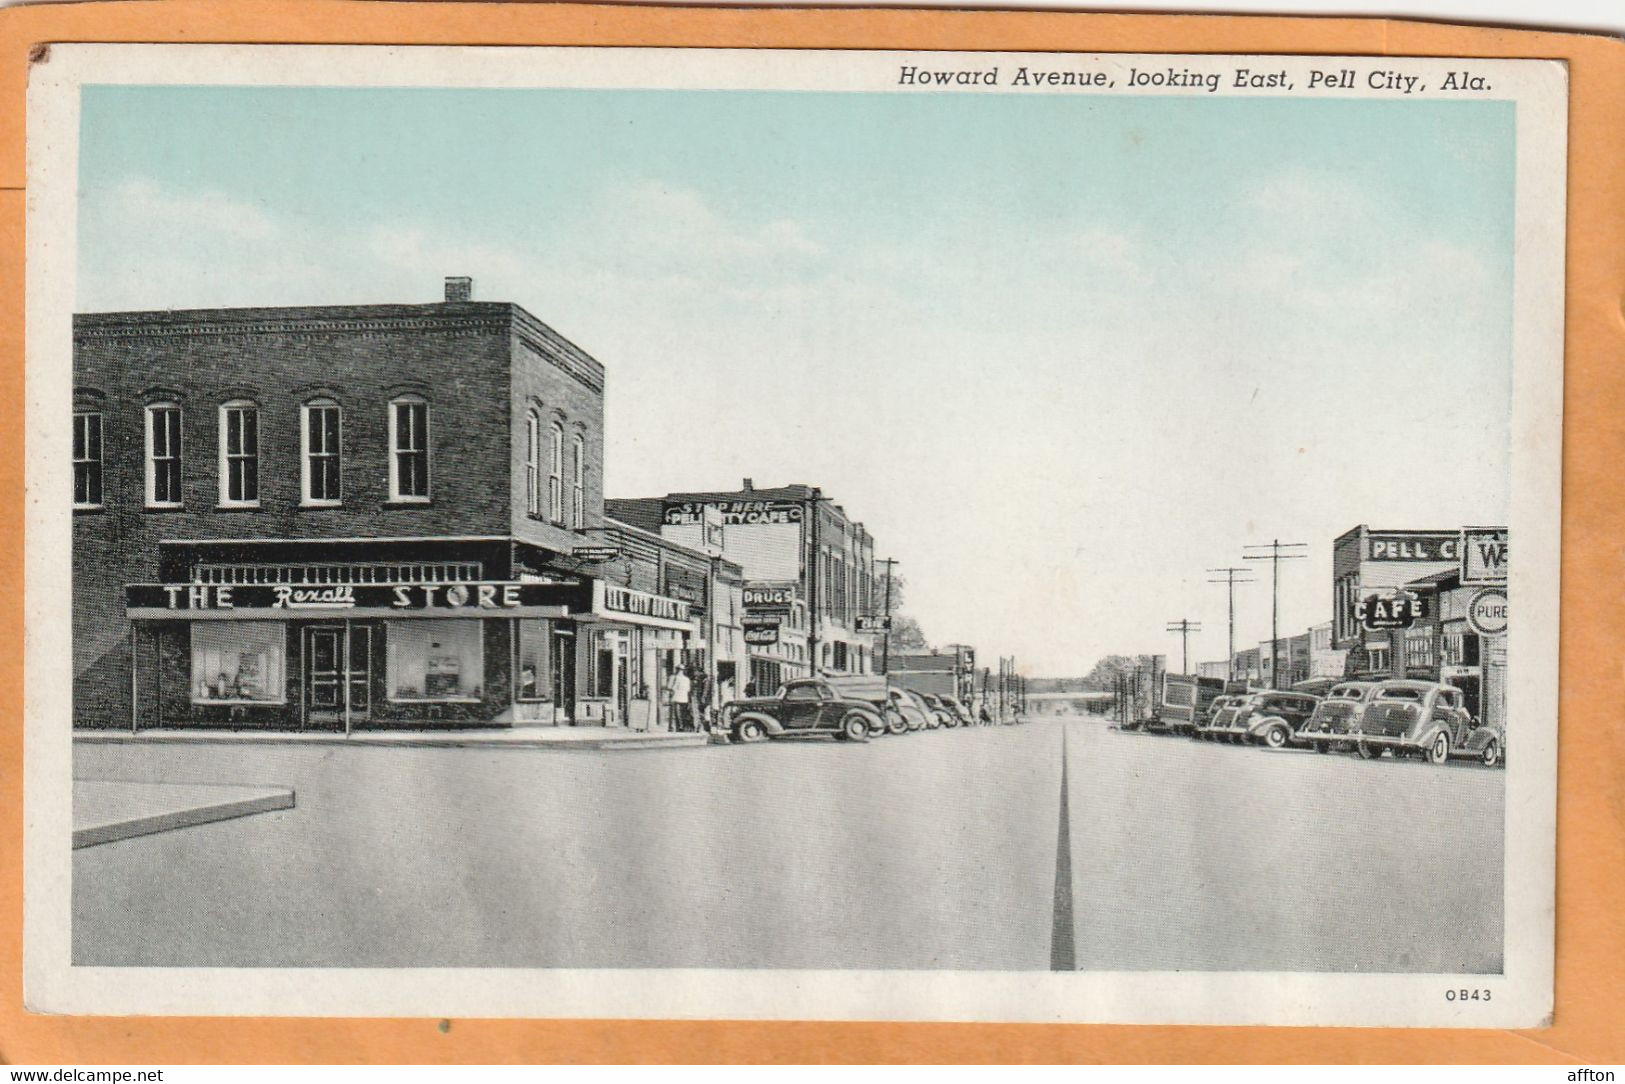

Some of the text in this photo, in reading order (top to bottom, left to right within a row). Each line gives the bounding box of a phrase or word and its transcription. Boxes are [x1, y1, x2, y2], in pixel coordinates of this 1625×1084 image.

[898, 66, 1492, 93] Howard Avenue, looking East, Pell City, Ala.
[731, 500, 774, 513] HERE
[1372, 541, 1429, 559] PELL
[163, 585, 522, 609] THE Rexall STORE
[743, 590, 792, 604] DRUGS
[1354, 600, 1423, 620] CAFE
